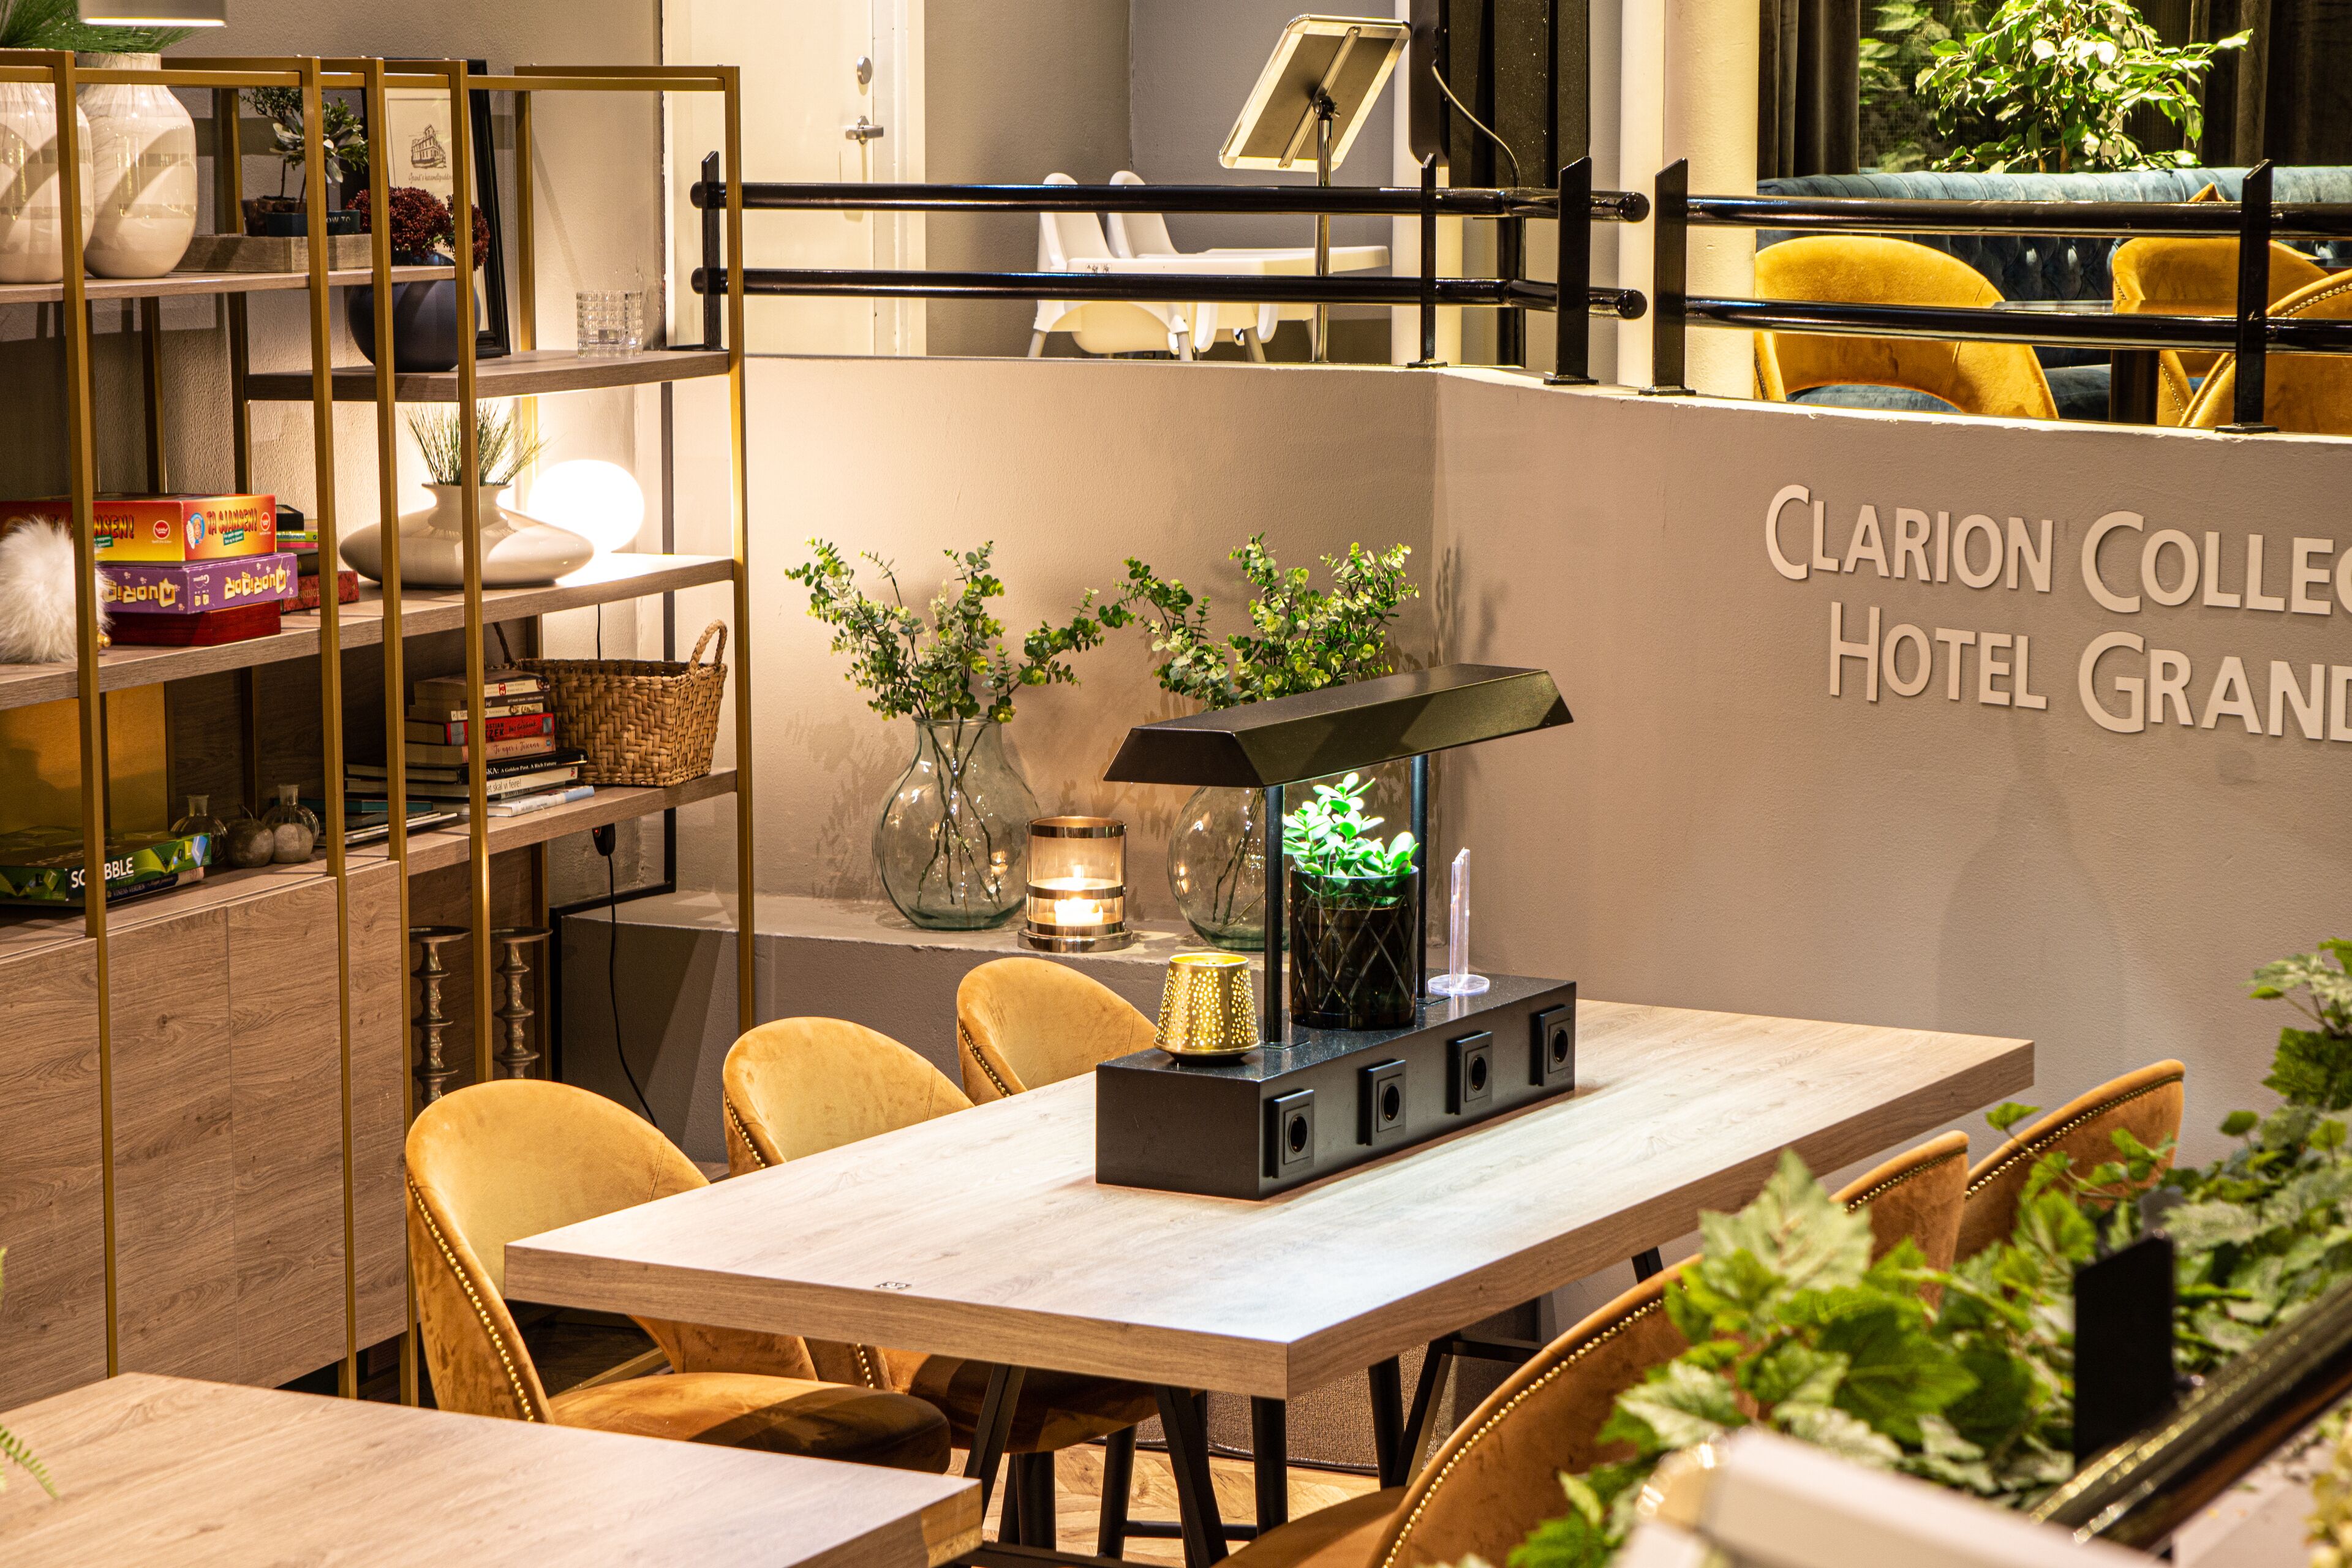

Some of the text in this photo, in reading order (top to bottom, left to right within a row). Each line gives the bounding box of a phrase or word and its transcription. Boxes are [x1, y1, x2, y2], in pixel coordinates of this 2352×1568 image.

[1766, 484, 2054, 593] CLARION
[1829, 601, 2048, 710] HOTEL
[493, 780, 503, 792] skal
[71, 857, 134, 888] SCBBLE
